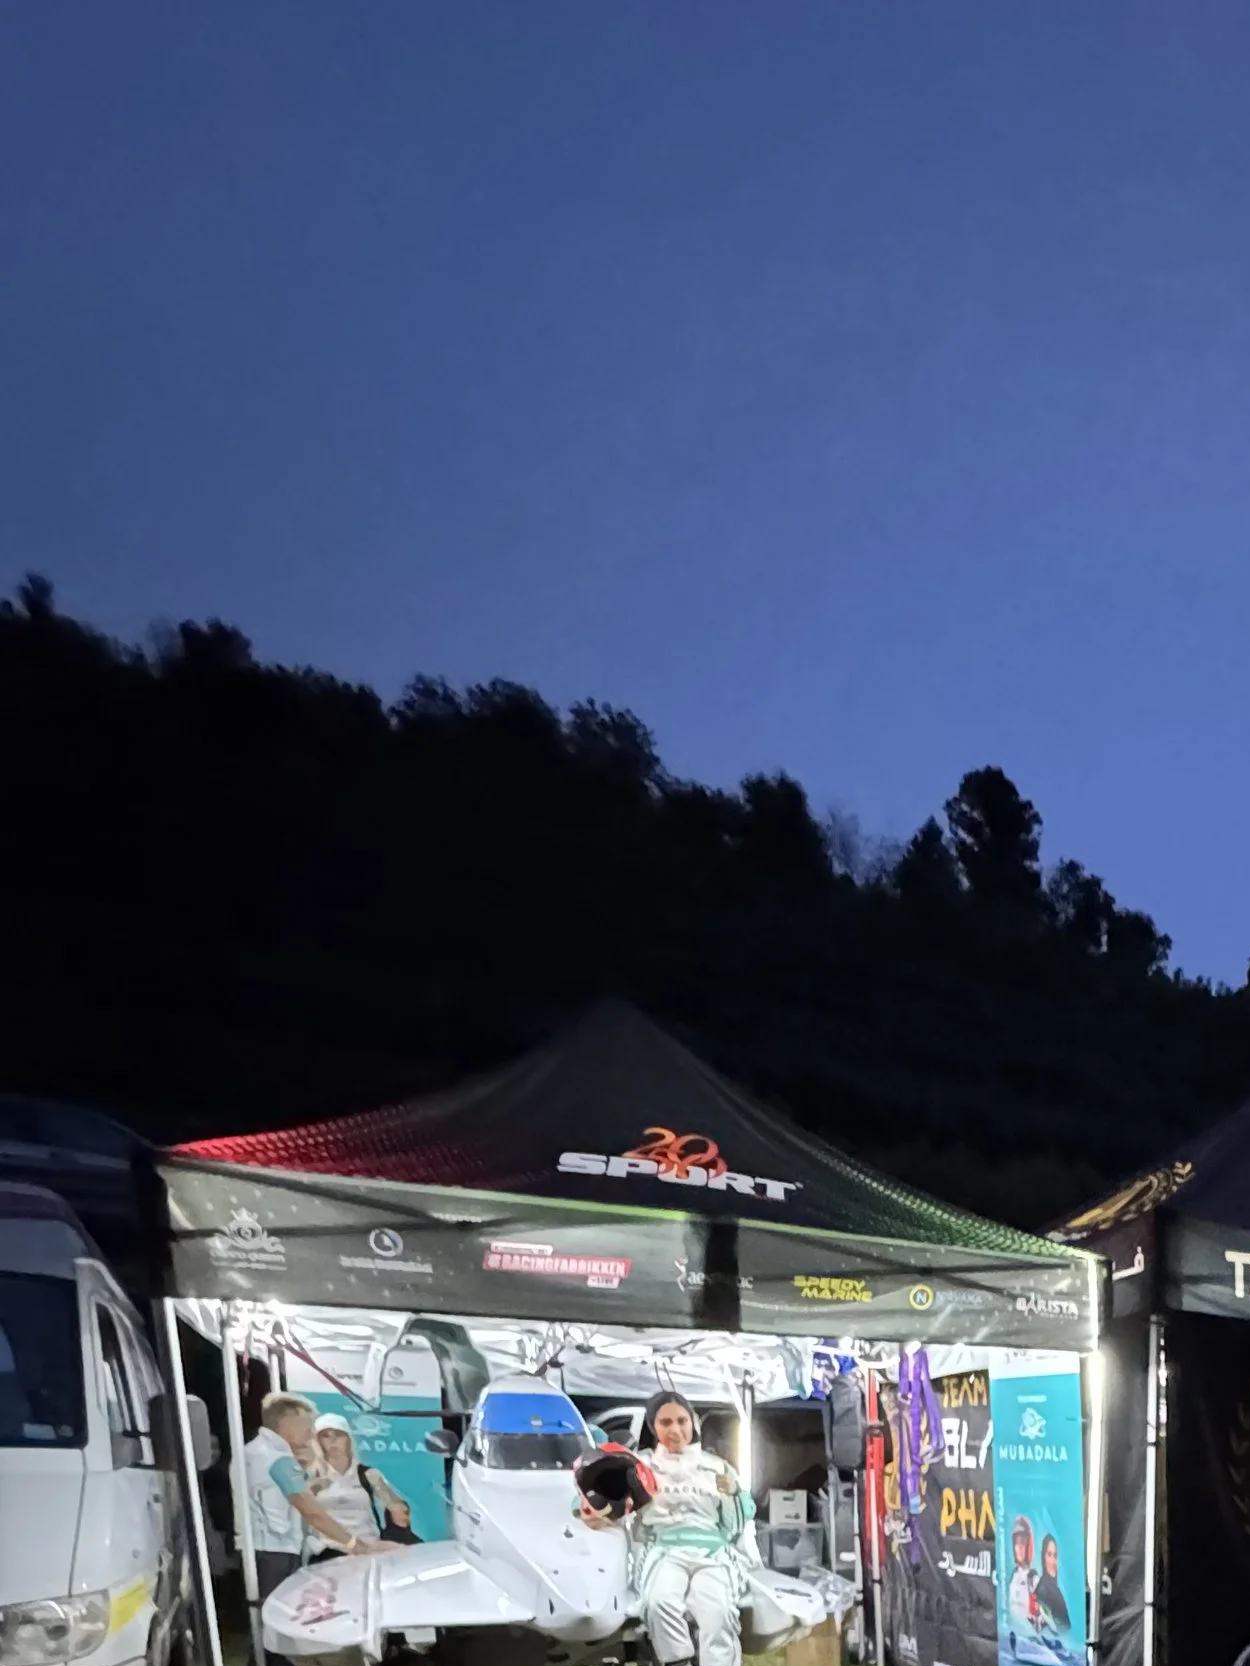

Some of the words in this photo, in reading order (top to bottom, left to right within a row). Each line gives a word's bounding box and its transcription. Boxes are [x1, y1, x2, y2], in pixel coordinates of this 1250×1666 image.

[556, 1152, 800, 1201] SPORT
[793, 1275, 866, 1292] SPEEDY
[801, 1287, 873, 1303] MARINE
[943, 1377, 987, 1408] TEAM
[358, 1439, 427, 1453] ADALA
[999, 1445, 1069, 1462] MUBADALA
